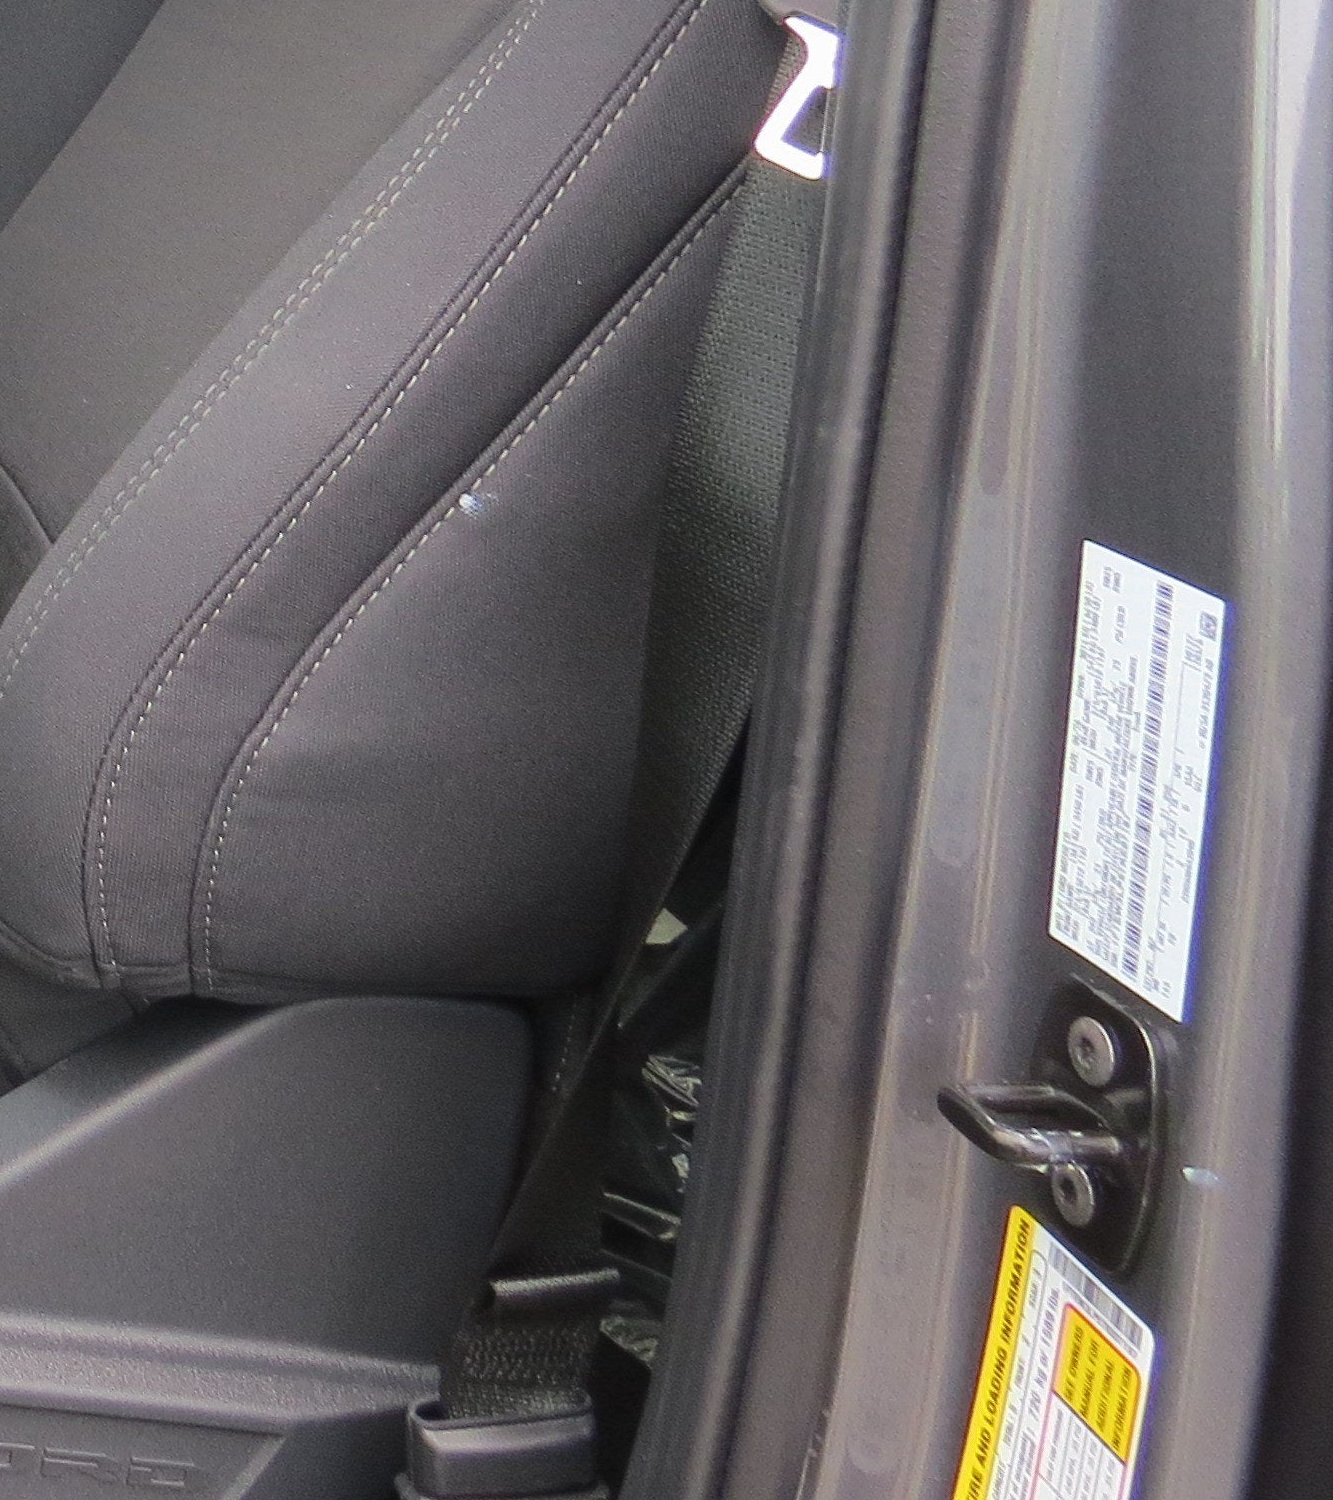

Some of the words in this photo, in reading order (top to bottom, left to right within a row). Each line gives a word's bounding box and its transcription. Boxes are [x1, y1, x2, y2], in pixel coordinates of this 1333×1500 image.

[1000, 1218, 1030, 1345] INFORMATION
[983, 1346, 1007, 1427] LOADING
[1079, 1365, 1095, 1419] MANUAL
[1088, 1338, 1099, 1367] FOR
[1095, 1359, 1115, 1432] ADDITIONAL
[1111, 1365, 1132, 1451] INFORMATION
[976, 1428, 991, 1468] AND
